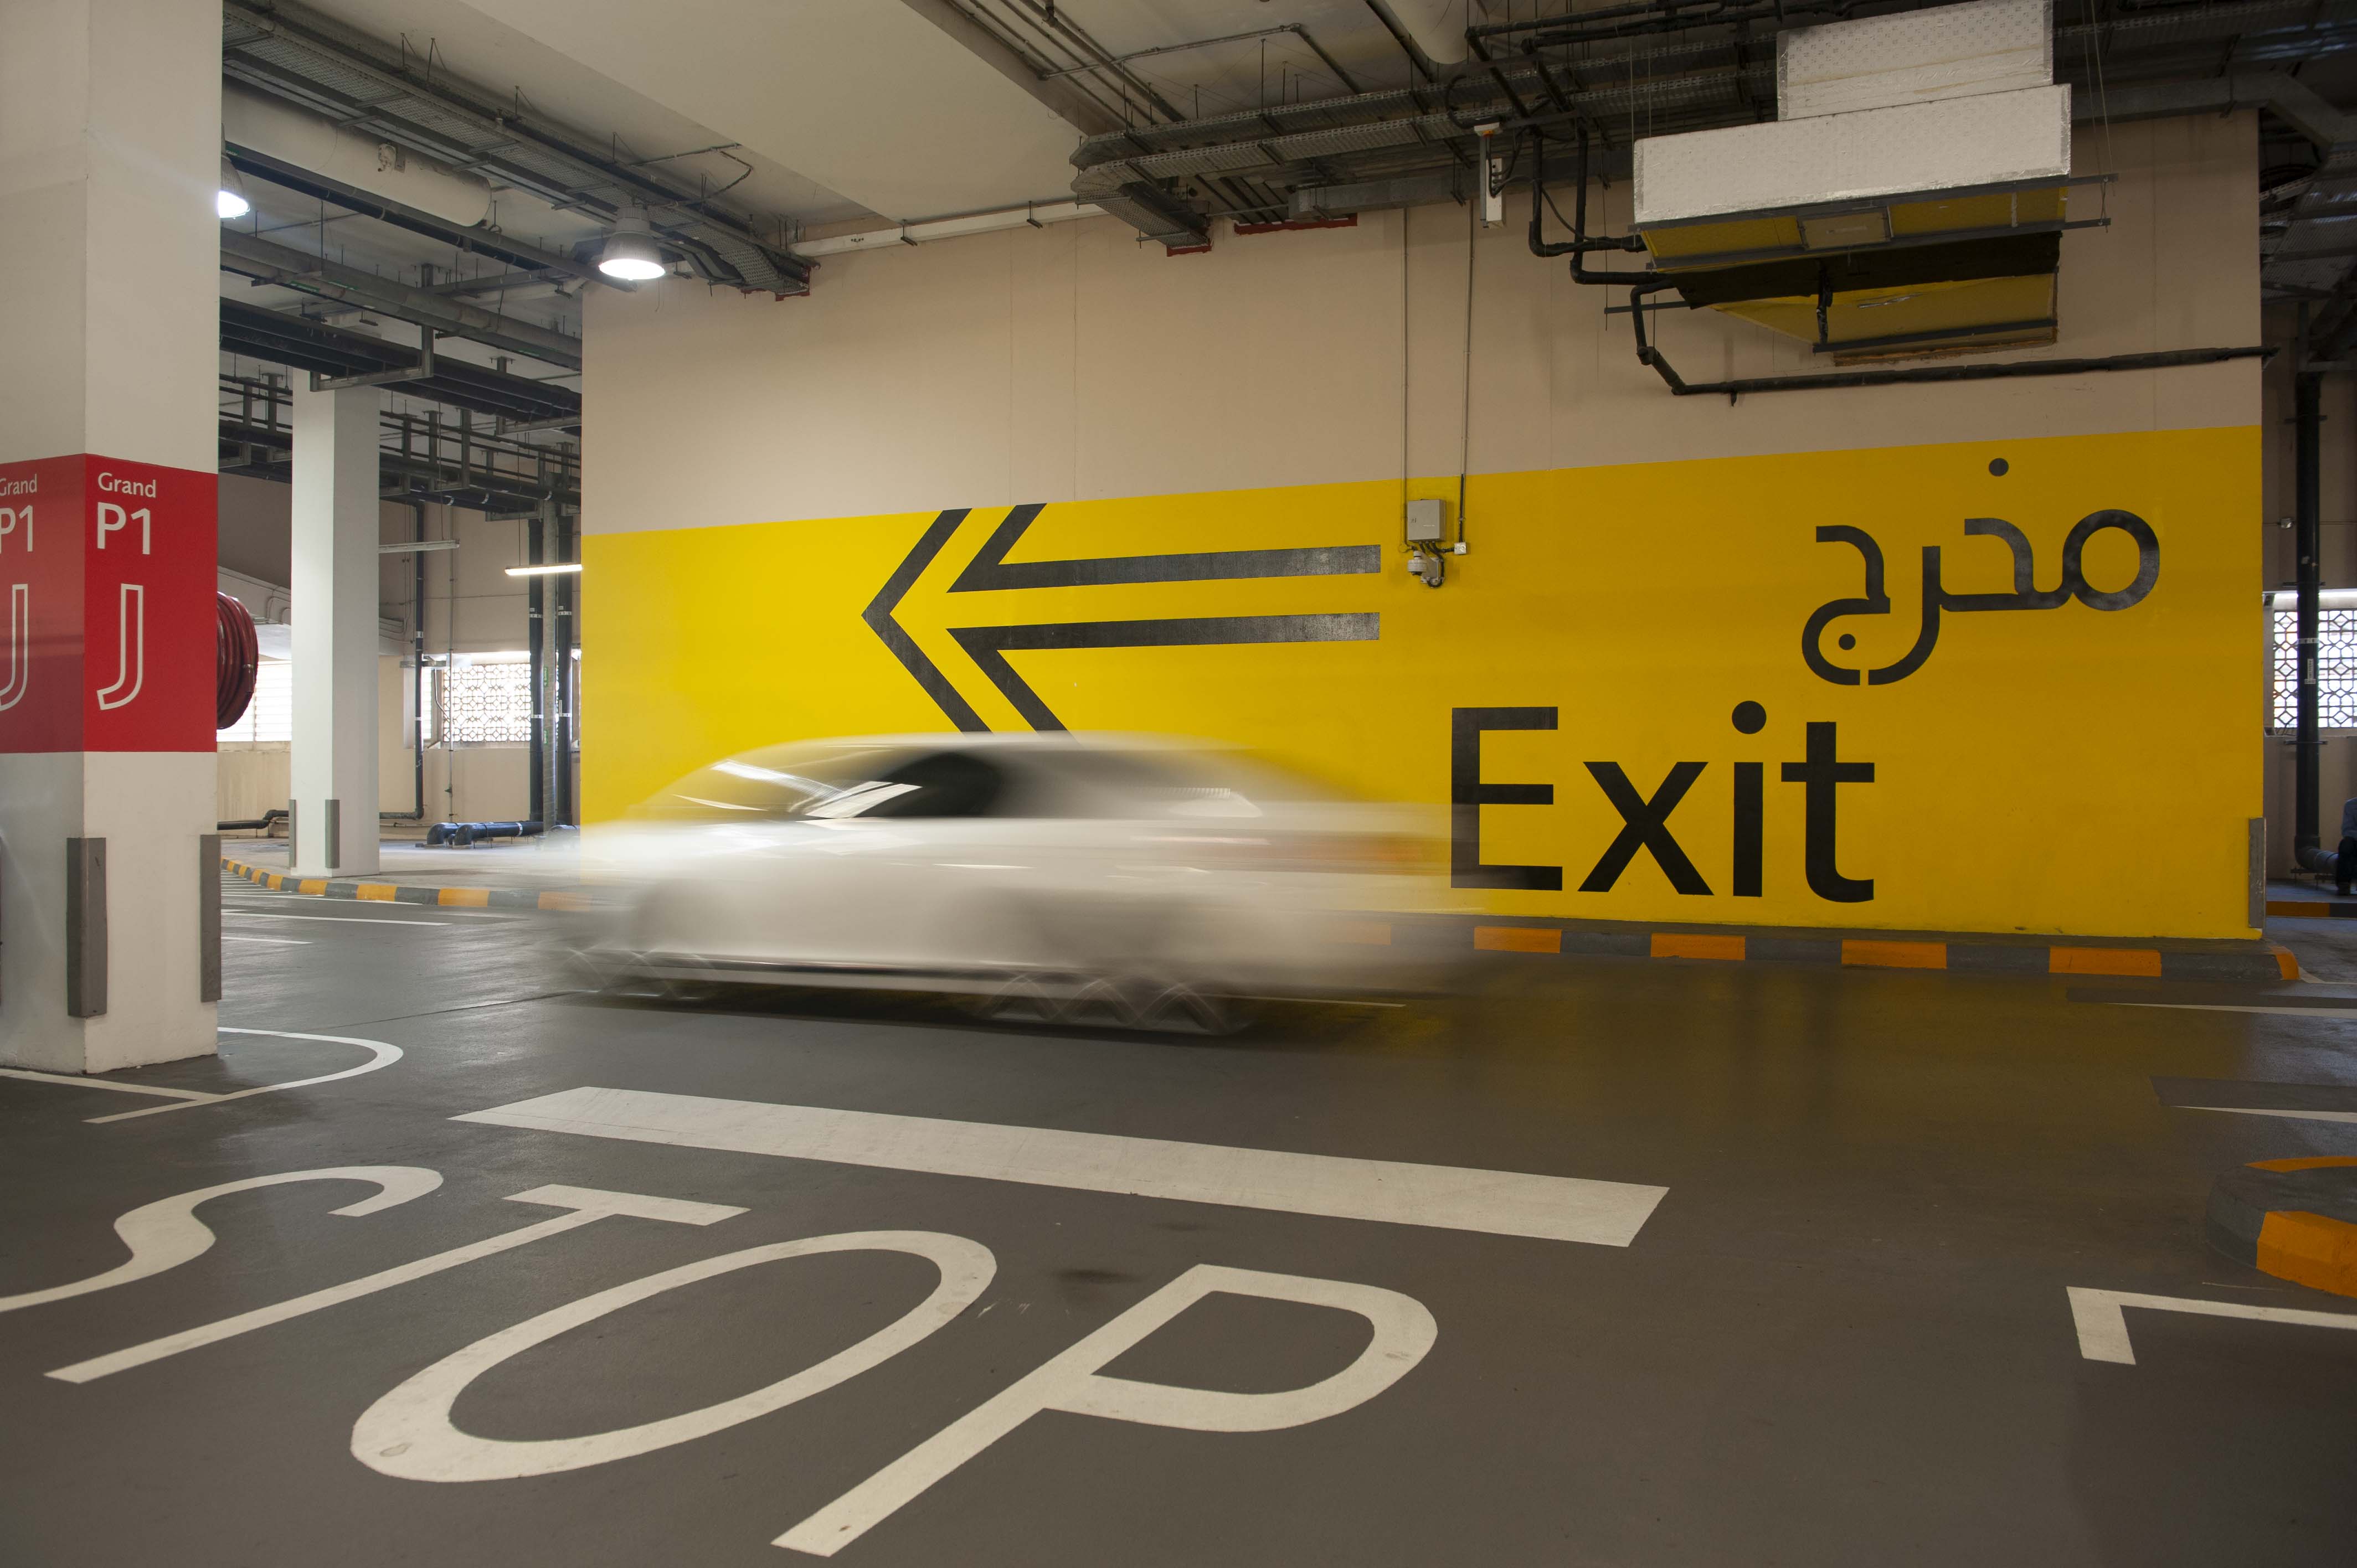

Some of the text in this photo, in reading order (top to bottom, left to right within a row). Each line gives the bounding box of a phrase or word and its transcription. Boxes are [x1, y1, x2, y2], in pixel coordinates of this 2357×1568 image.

[0, 474, 37, 496] Grand
[0, 505, 33, 554] P1
[97, 502, 151, 555] P1
[98, 472, 156, 498] Grand
[1802, 458, 2160, 685] مخرج
[96, 583, 143, 710] J
[1452, 701, 1875, 903] Exit
[0, 1165, 1438, 1557] STOP
